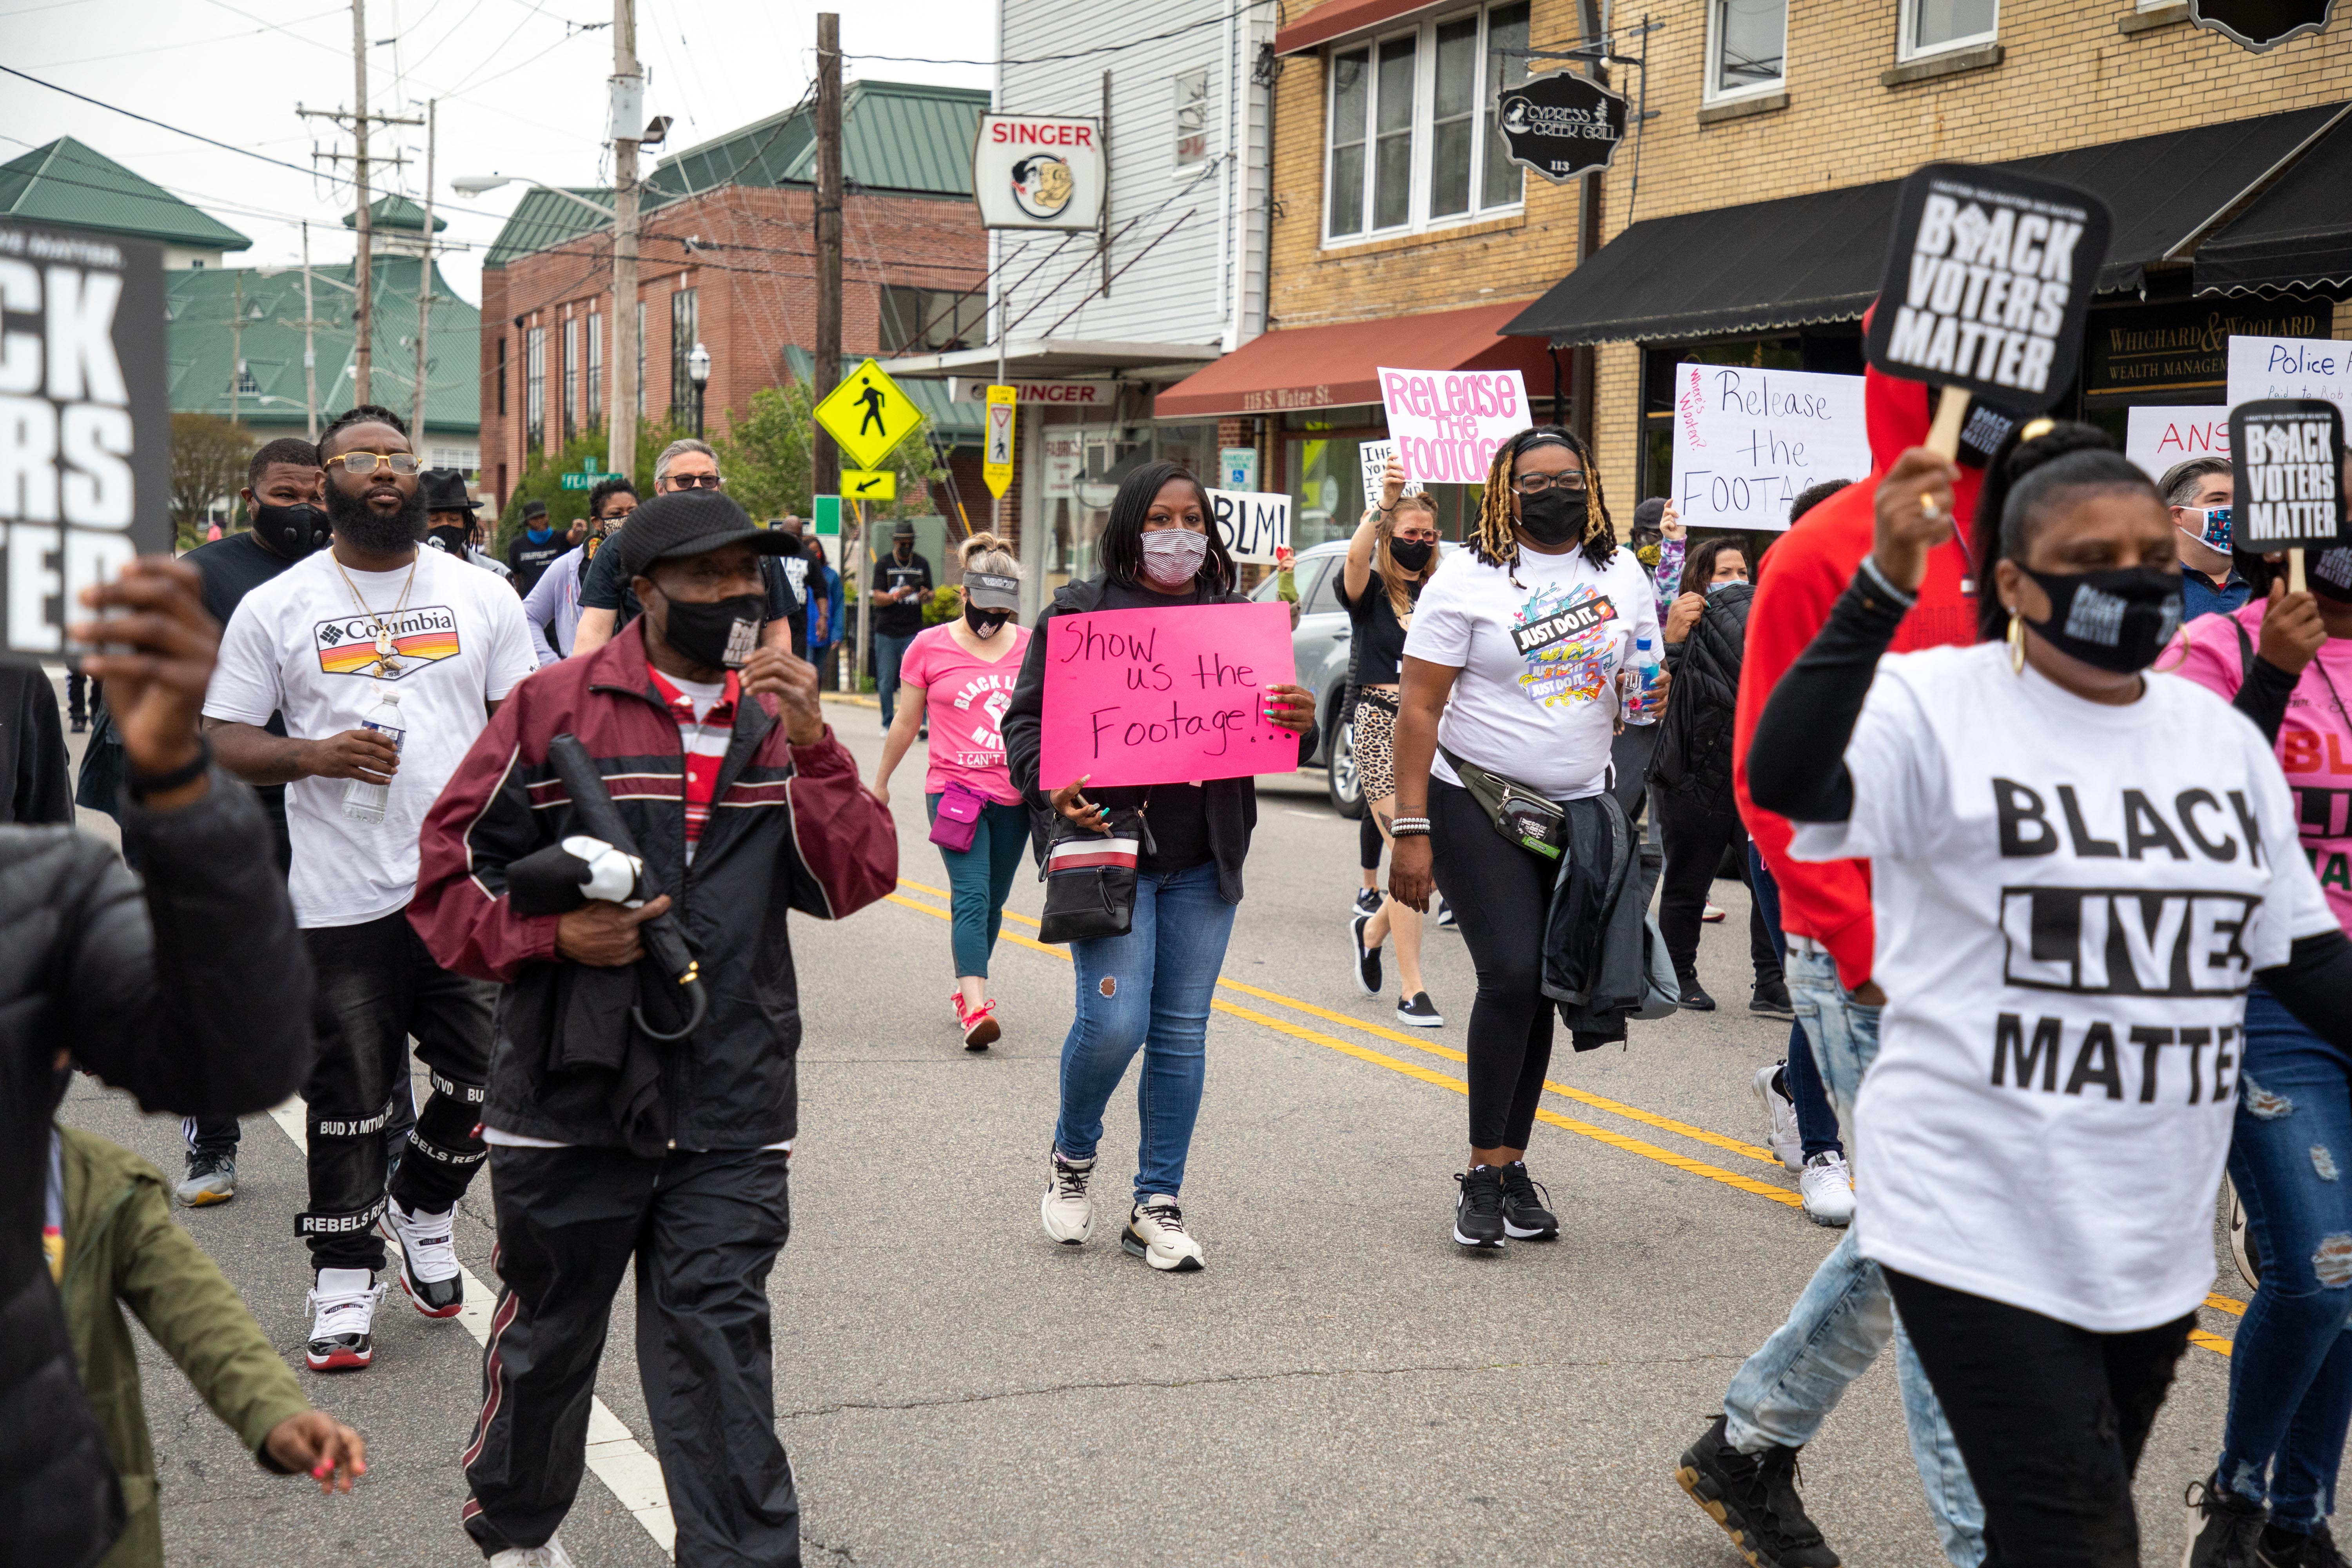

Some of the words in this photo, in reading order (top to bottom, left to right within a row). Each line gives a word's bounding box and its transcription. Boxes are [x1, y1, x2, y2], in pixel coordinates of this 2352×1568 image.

[1527, 105, 1590, 123] CYPRESS
[1532, 122, 1578, 138] CREEK
[1582, 125, 1619, 141] GRILL
[993, 123, 1091, 146] SINGER
[1550, 160, 1570, 172] 113
[1907, 254, 2071, 338] VOTERS
[1886, 306, 2056, 394] MATTER
[2110, 326, 2201, 352] WHICHARD
[2201, 312, 2229, 351] &
[2224, 315, 2315, 348] WOOLARD
[2110, 361, 2158, 380] WEALTH
[2269, 345, 2335, 375] Police
[1276, 389, 1312, 407] Water
[1315, 385, 1333, 405] St.
[1690, 368, 1706, 414] Where's
[1714, 370, 1832, 420] Release
[2268, 385, 2288, 399] Paid
[2302, 384, 2312, 399] to
[2321, 385, 2343, 400] Rob
[1679, 392, 1707, 451] Wooten?
[1736, 429, 1808, 467] the
[2247, 463, 2335, 501] VOTERS
[1214, 495, 1285, 556] BLM!
[2249, 501, 2337, 540] MATTER
[346, 612, 452, 639] Columbia
[1060, 621, 1156, 662] Show
[1519, 622, 1555, 650] JUST
[1552, 613, 1580, 634] DO
[1575, 606, 1599, 626] IT.
[1127, 663, 1172, 691] us
[1191, 653, 1257, 689] the
[1532, 680, 1555, 697] JUST
[1555, 677, 1572, 691] DO
[1573, 674, 1586, 685] IT.
[1625, 672, 1644, 689] FIJI
[954, 675, 1002, 710] BLACK
[958, 754, 964, 765] I
[967, 753, 1000, 765] CAN'T
[2004, 893, 2252, 992] LIVE
[1991, 1012, 2245, 1106] MATTE
[320, 1121, 345, 1136] BUD
[348, 1122, 358, 1136] X
[359, 1114, 384, 1134] MTVD
[303, 1212, 369, 1232] REBELS
